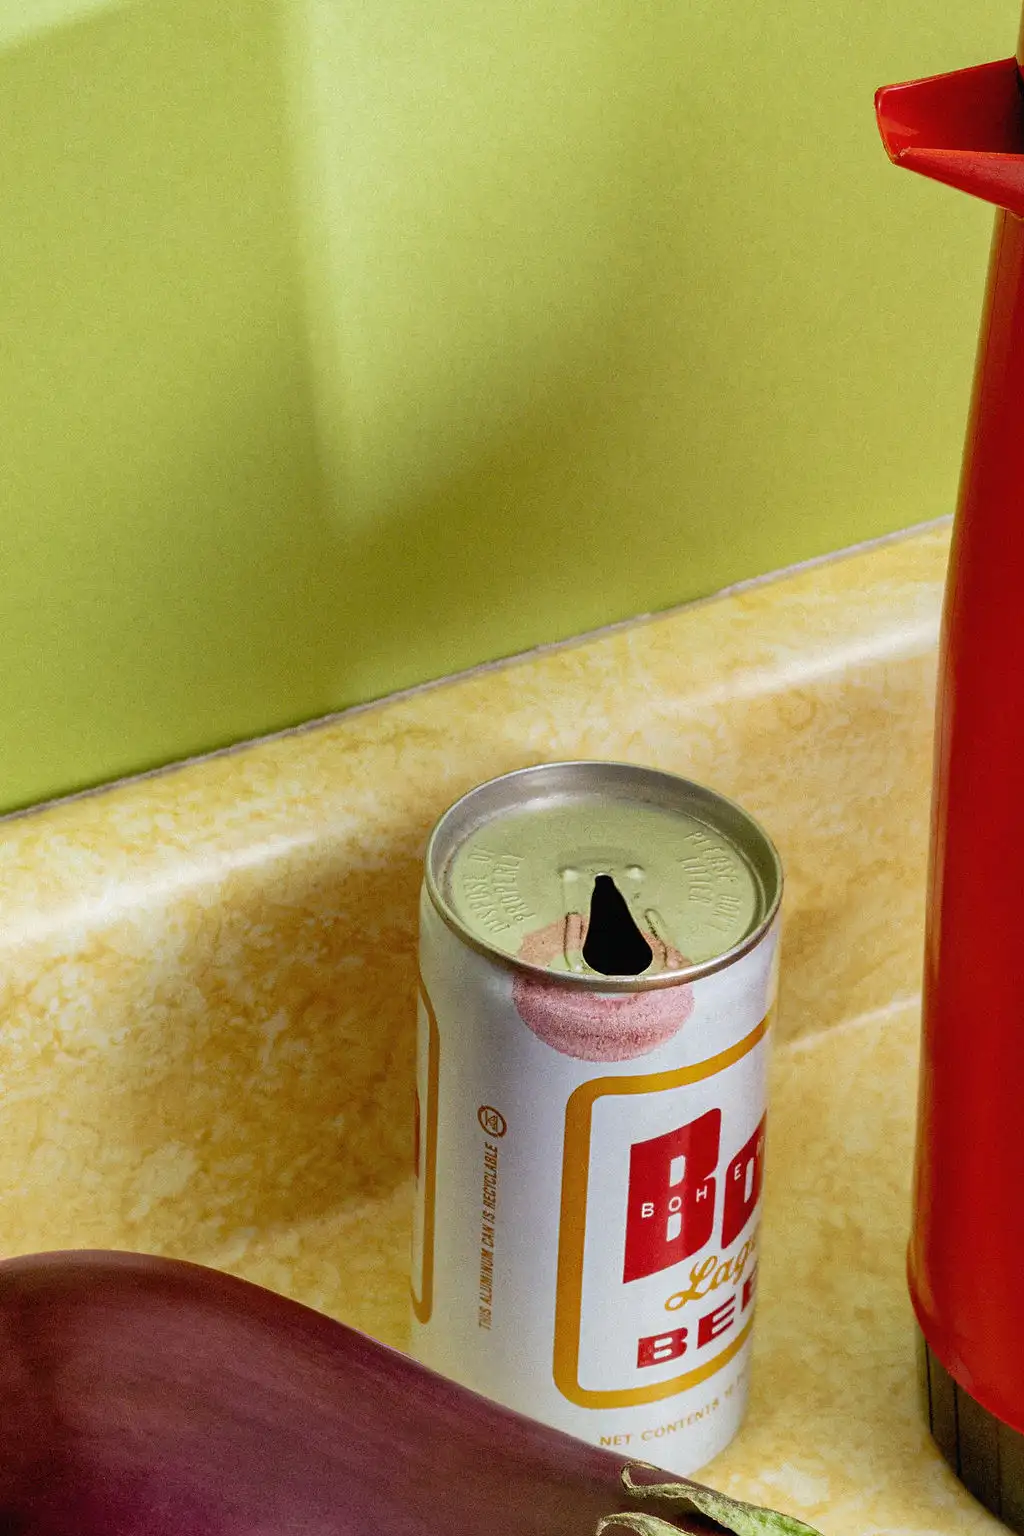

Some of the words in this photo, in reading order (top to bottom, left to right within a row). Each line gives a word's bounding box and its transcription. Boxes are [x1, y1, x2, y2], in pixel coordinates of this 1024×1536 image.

[462, 873, 511, 934] DISPOSE
[491, 848, 537, 922] PROPERLY
[483, 1141, 499, 1210] RECYCLABLE
[481, 1223, 495, 1249] CAN
[482, 1209, 497, 1225] IS
[480, 1248, 494, 1306] ALUMINUM
[479, 1306, 493, 1331] THIS
[599, 1433, 633, 1447] NET
[640, 1397, 720, 1442] CONTENTS
